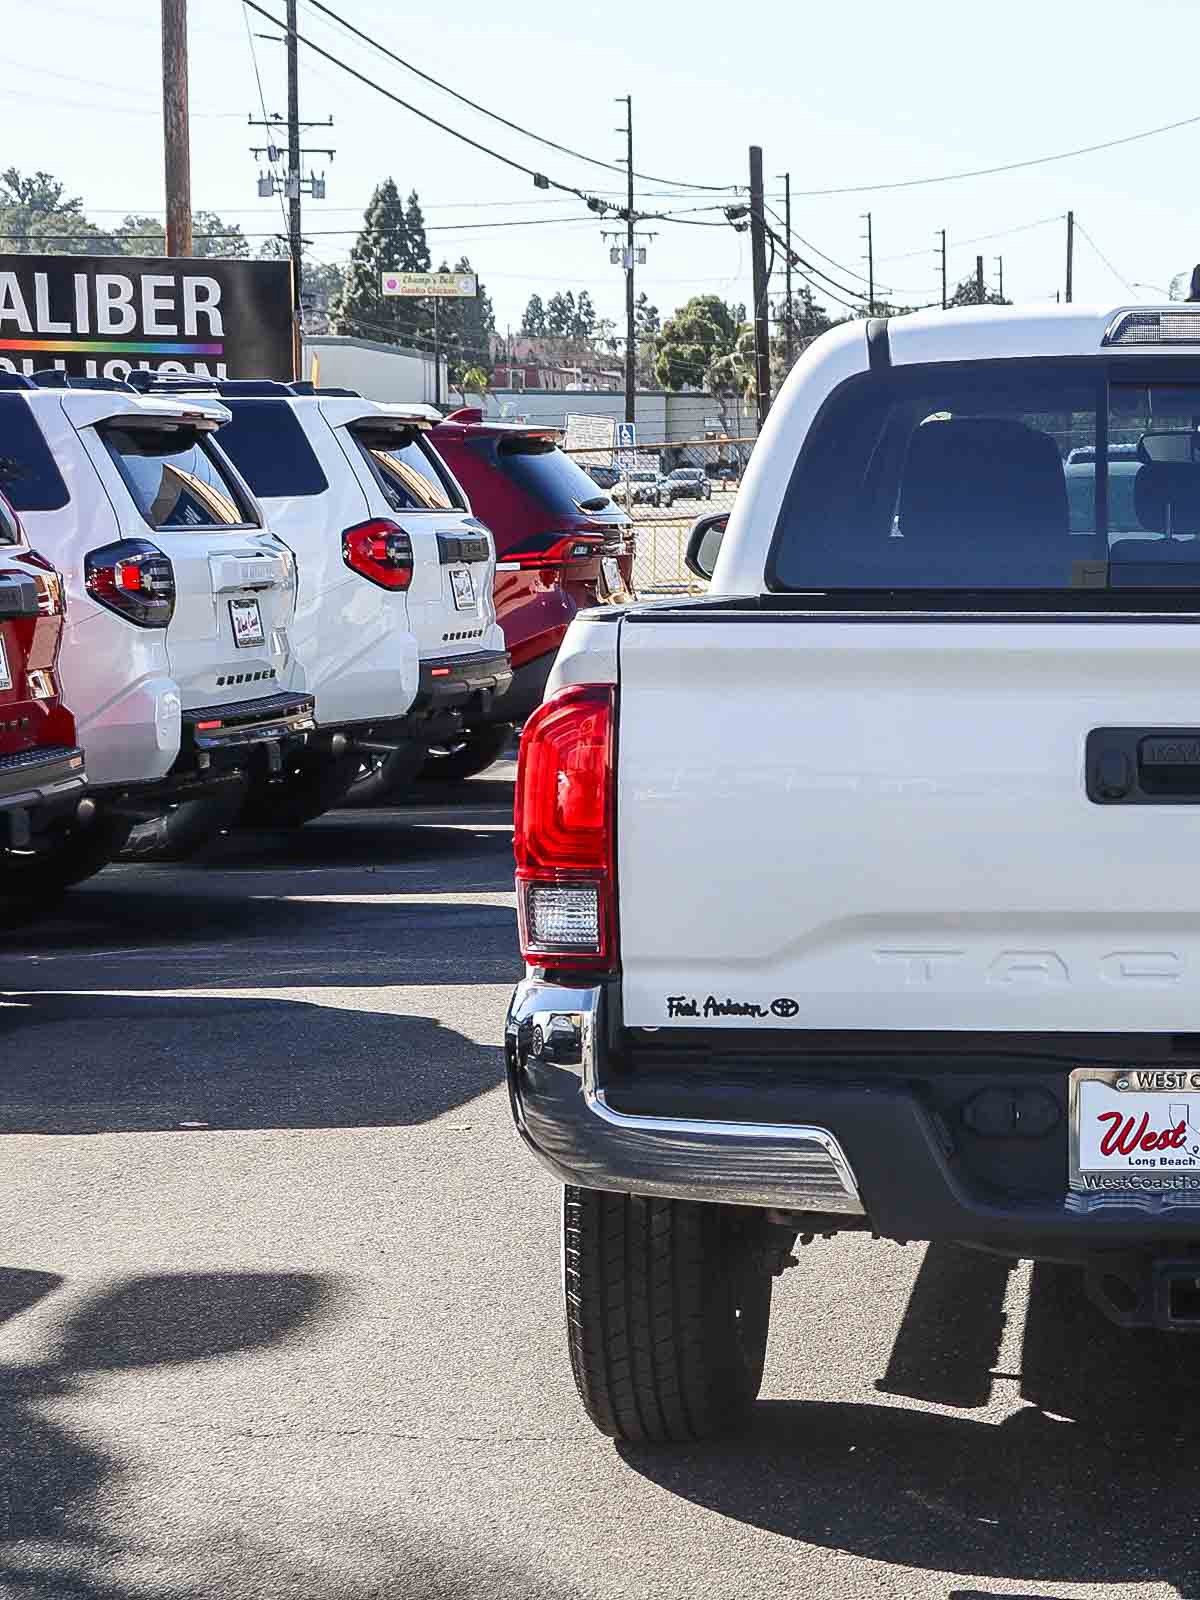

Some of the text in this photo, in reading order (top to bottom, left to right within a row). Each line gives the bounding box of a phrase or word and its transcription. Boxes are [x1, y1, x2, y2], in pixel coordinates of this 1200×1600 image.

[0, 271, 225, 337] ALIBER
[666, 996, 700, 1018] Fred
[1136, 1072, 1186, 1089] WEST
[1097, 1111, 1187, 1157] West
[1128, 1156, 1196, 1167] Long Beach
